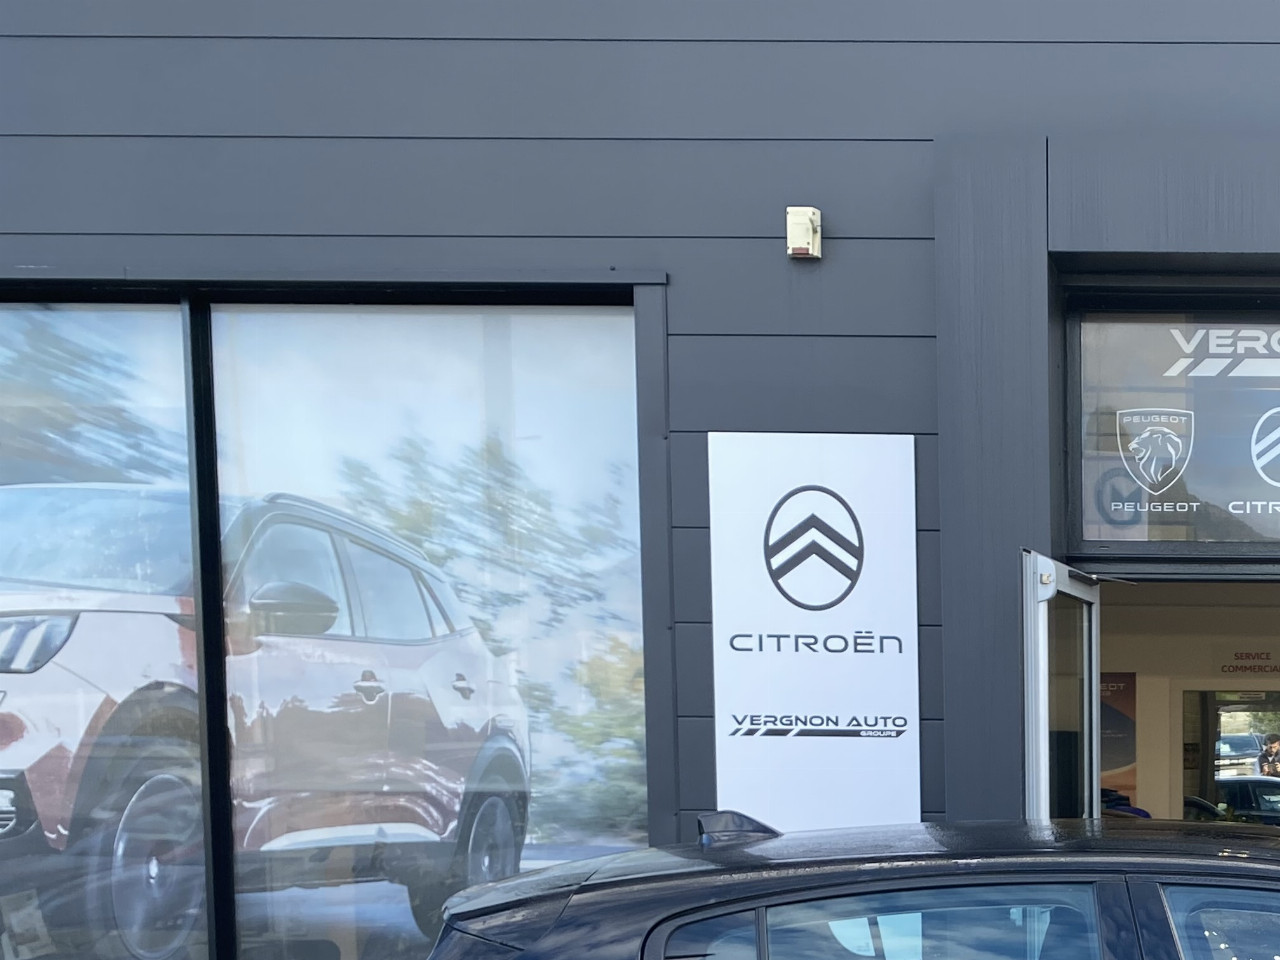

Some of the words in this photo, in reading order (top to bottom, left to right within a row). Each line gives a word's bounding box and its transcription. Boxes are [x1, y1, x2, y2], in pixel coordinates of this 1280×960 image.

[1122, 414, 1188, 424] PEUGEOT
[1110, 502, 1201, 513] PEUGEOT
[1234, 652, 1271, 661] SERVICE
[731, 714, 839, 728] VERGNON
[845, 716, 908, 728] AUTO
